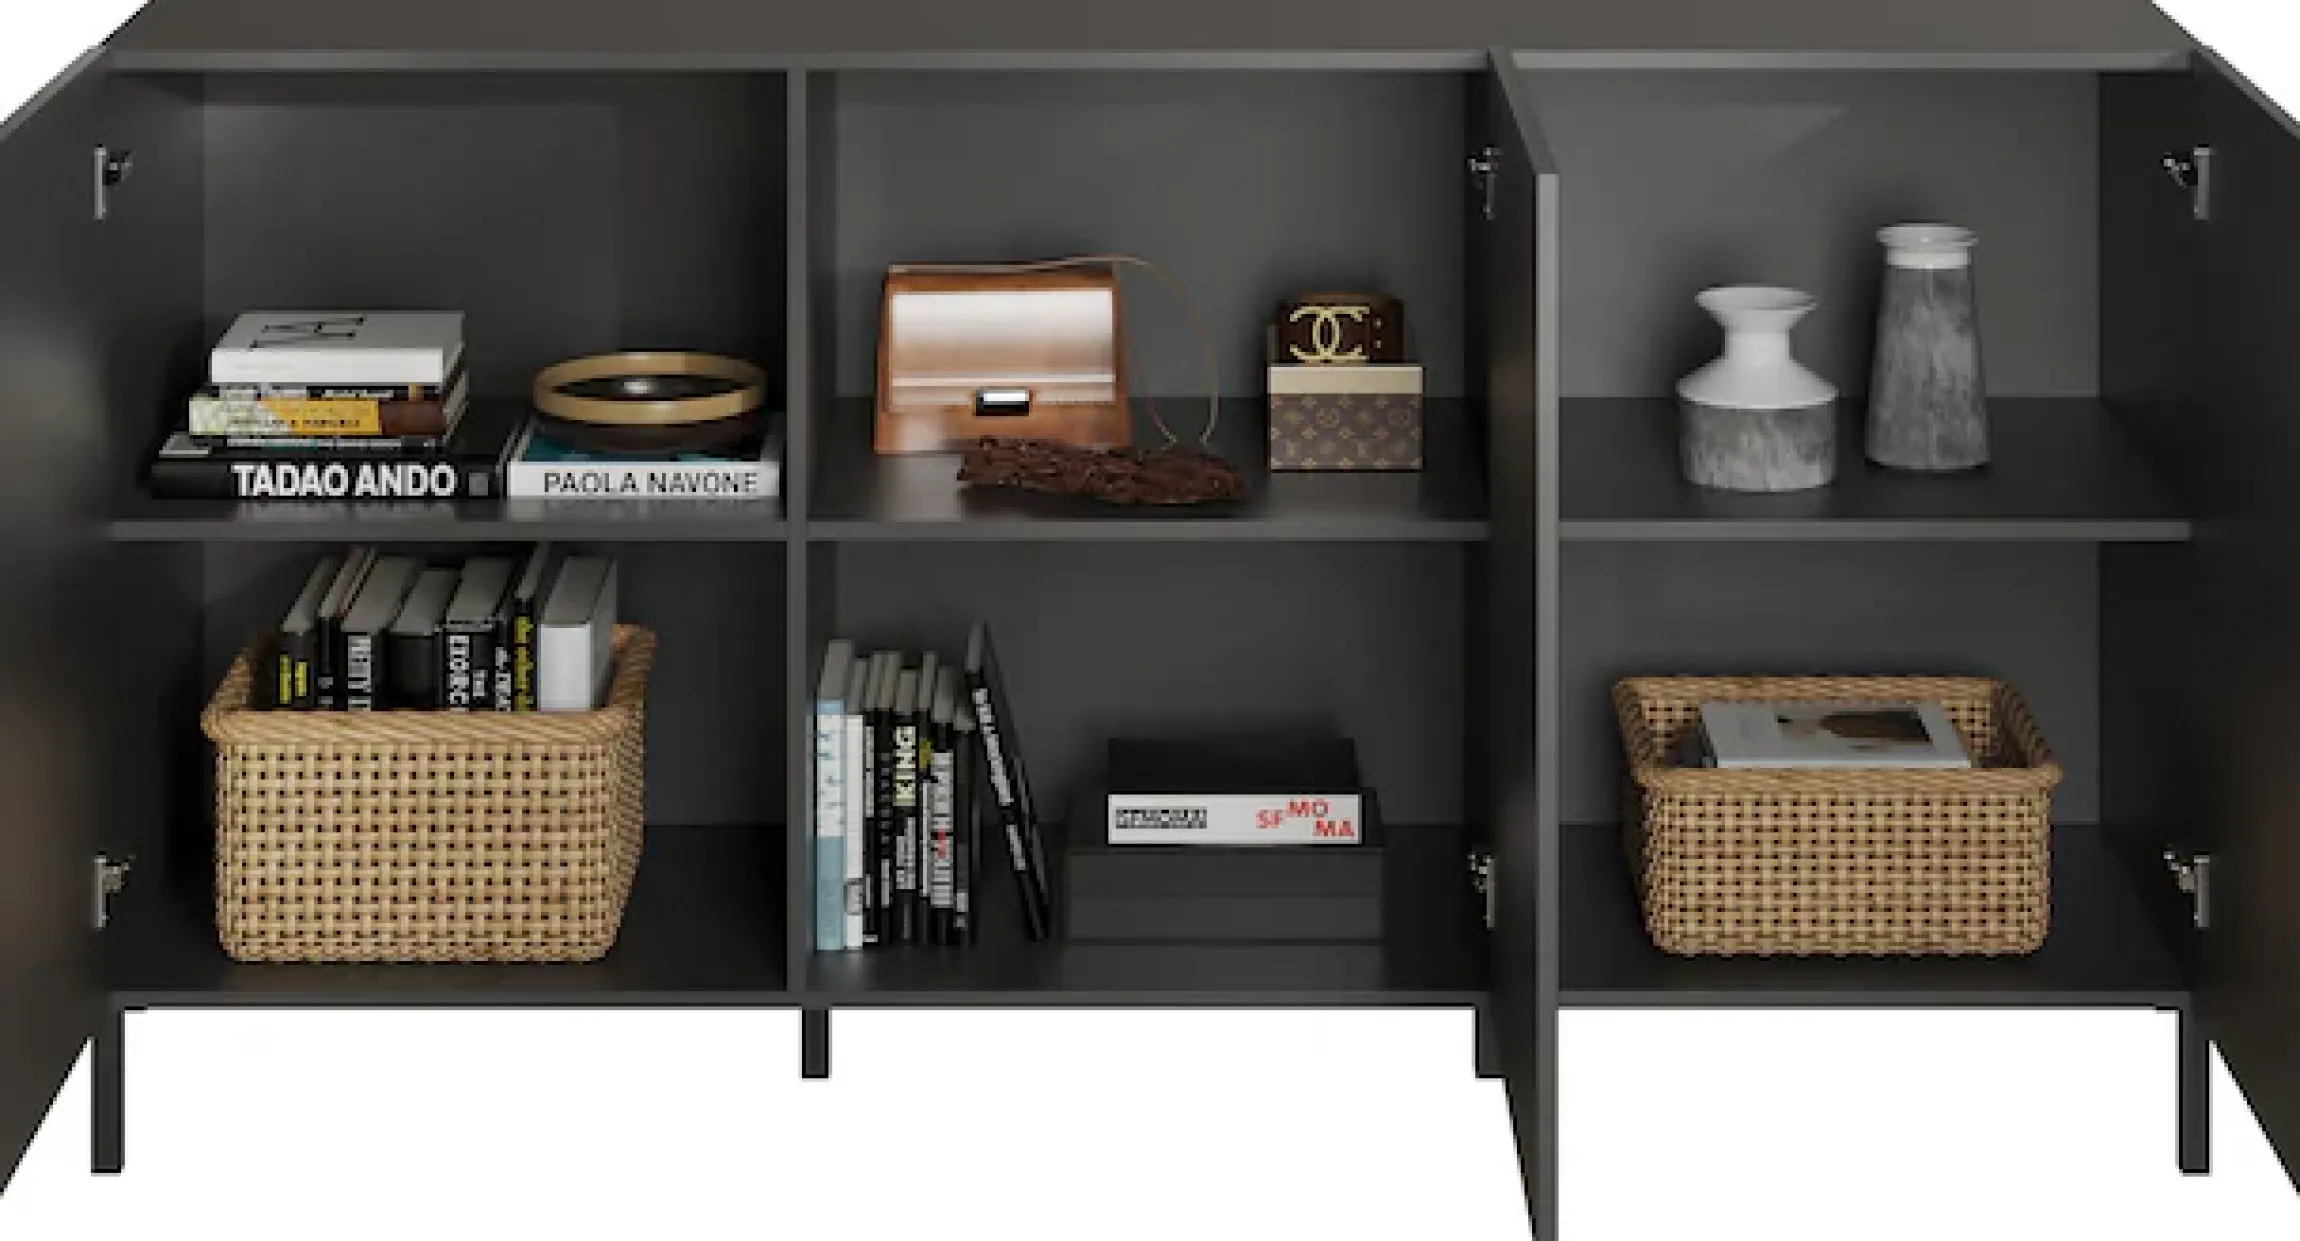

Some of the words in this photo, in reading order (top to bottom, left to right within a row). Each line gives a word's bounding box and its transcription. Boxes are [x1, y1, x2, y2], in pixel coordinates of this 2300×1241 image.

[231, 464, 349, 497] TADAO
[355, 464, 458, 497] ANDO
[544, 470, 640, 493] PAOLA
[647, 470, 757, 493] NAVONE
[892, 725, 917, 807] KING
[1255, 809, 1283, 830] SF
[1286, 798, 1331, 819] MO
[1312, 818, 1356, 837] MA
